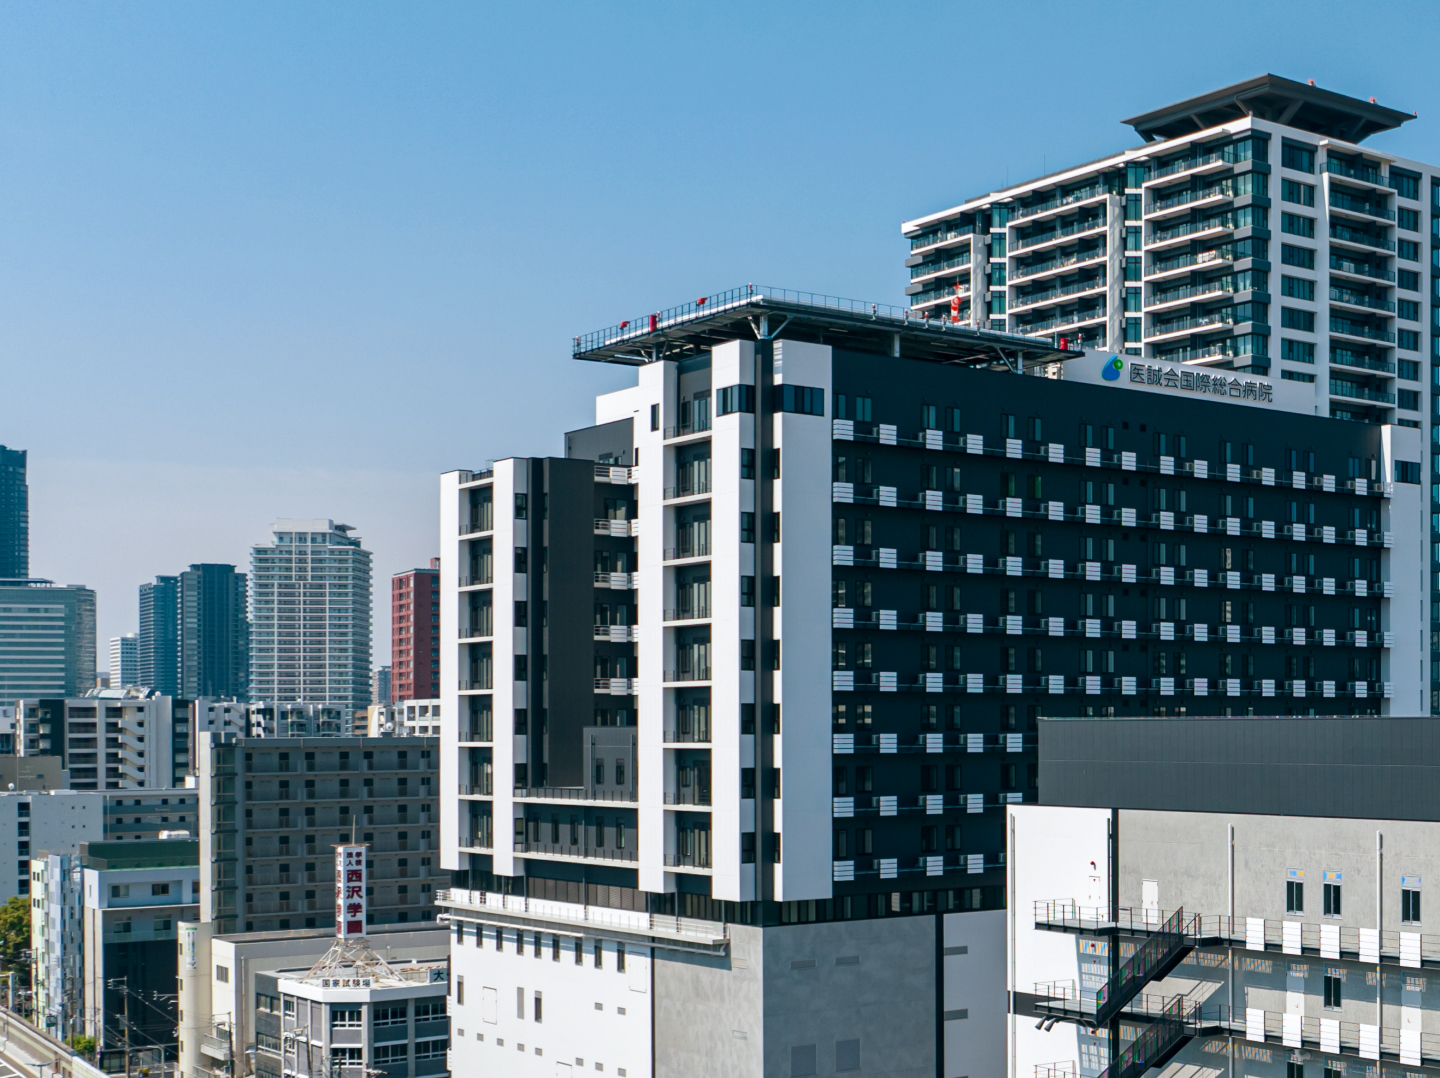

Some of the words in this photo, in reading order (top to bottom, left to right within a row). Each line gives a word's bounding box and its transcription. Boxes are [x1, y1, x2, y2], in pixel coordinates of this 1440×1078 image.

[1129, 362, 1273, 403] 医誠会国際総合病院
